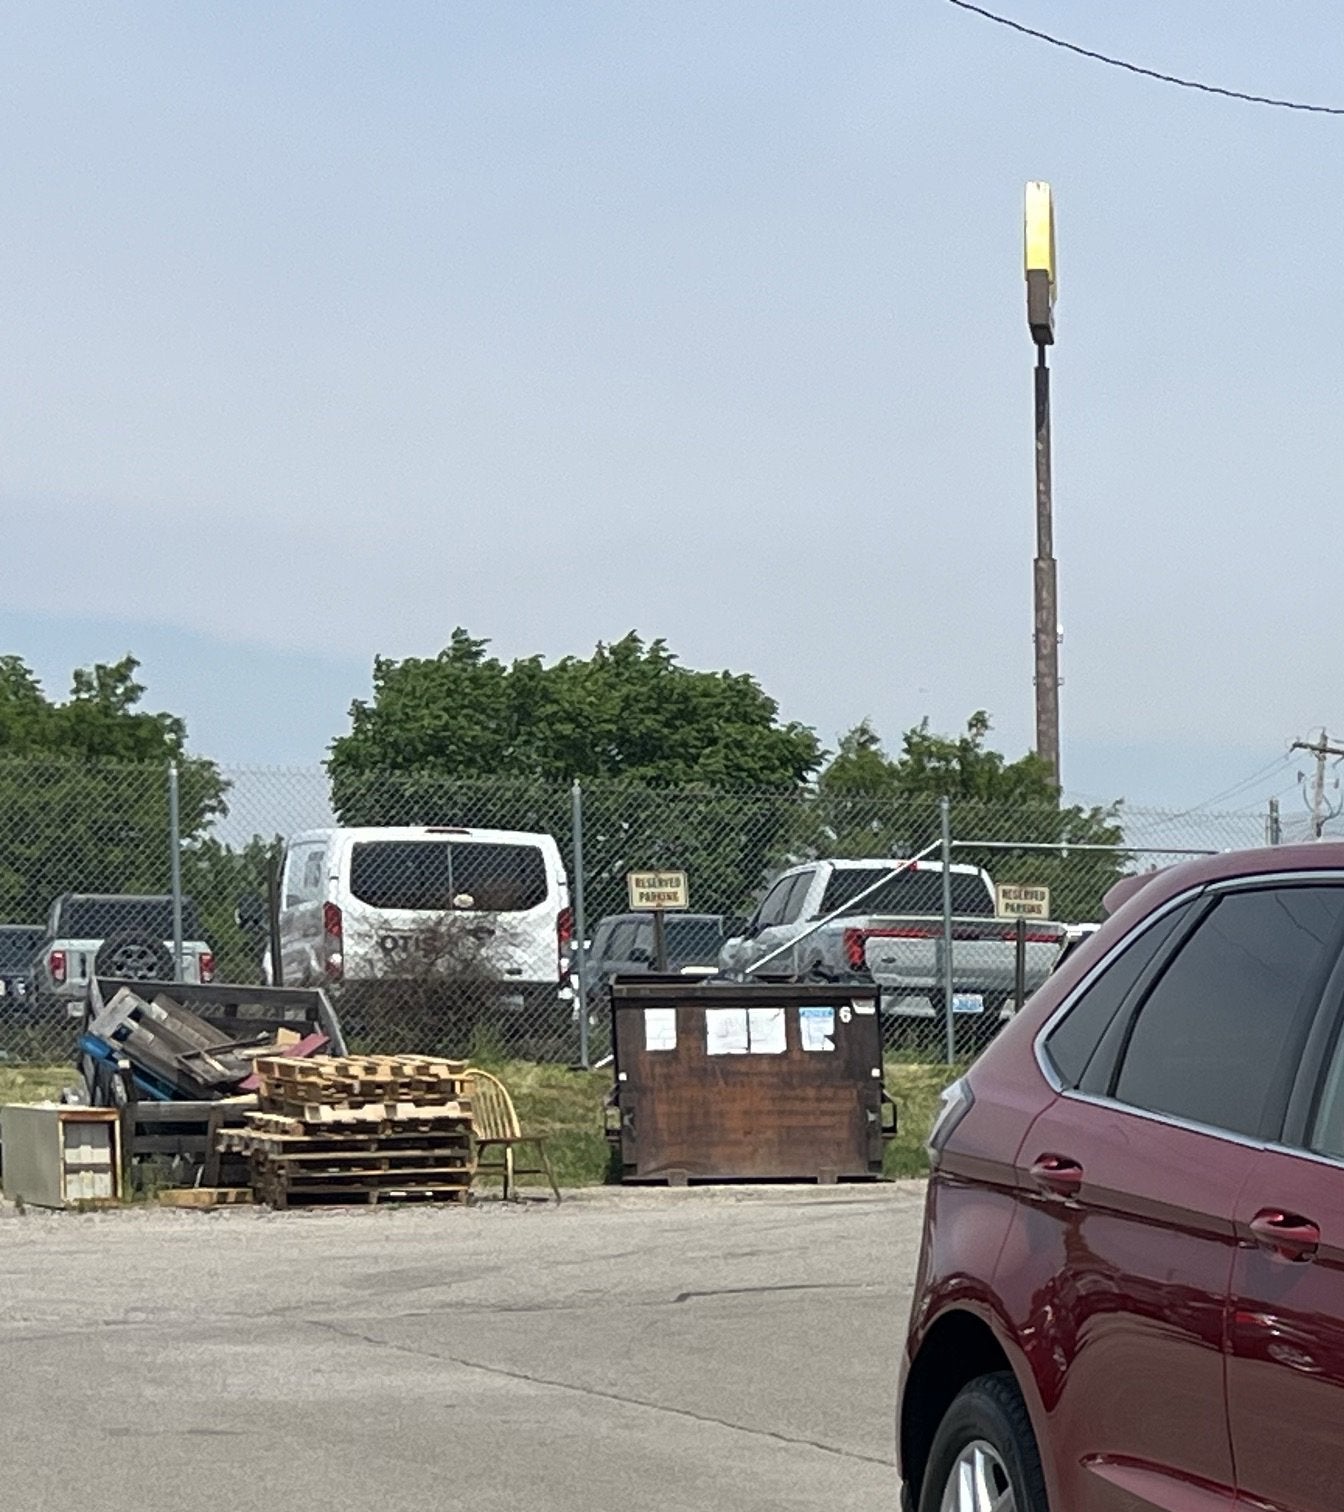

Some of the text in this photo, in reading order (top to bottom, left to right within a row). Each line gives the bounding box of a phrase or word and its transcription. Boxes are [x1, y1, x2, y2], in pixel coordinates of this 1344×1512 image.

[634, 877, 681, 888] RESERVED
[639, 891, 679, 902] PARKING
[838, 1006, 852, 1023] 6
